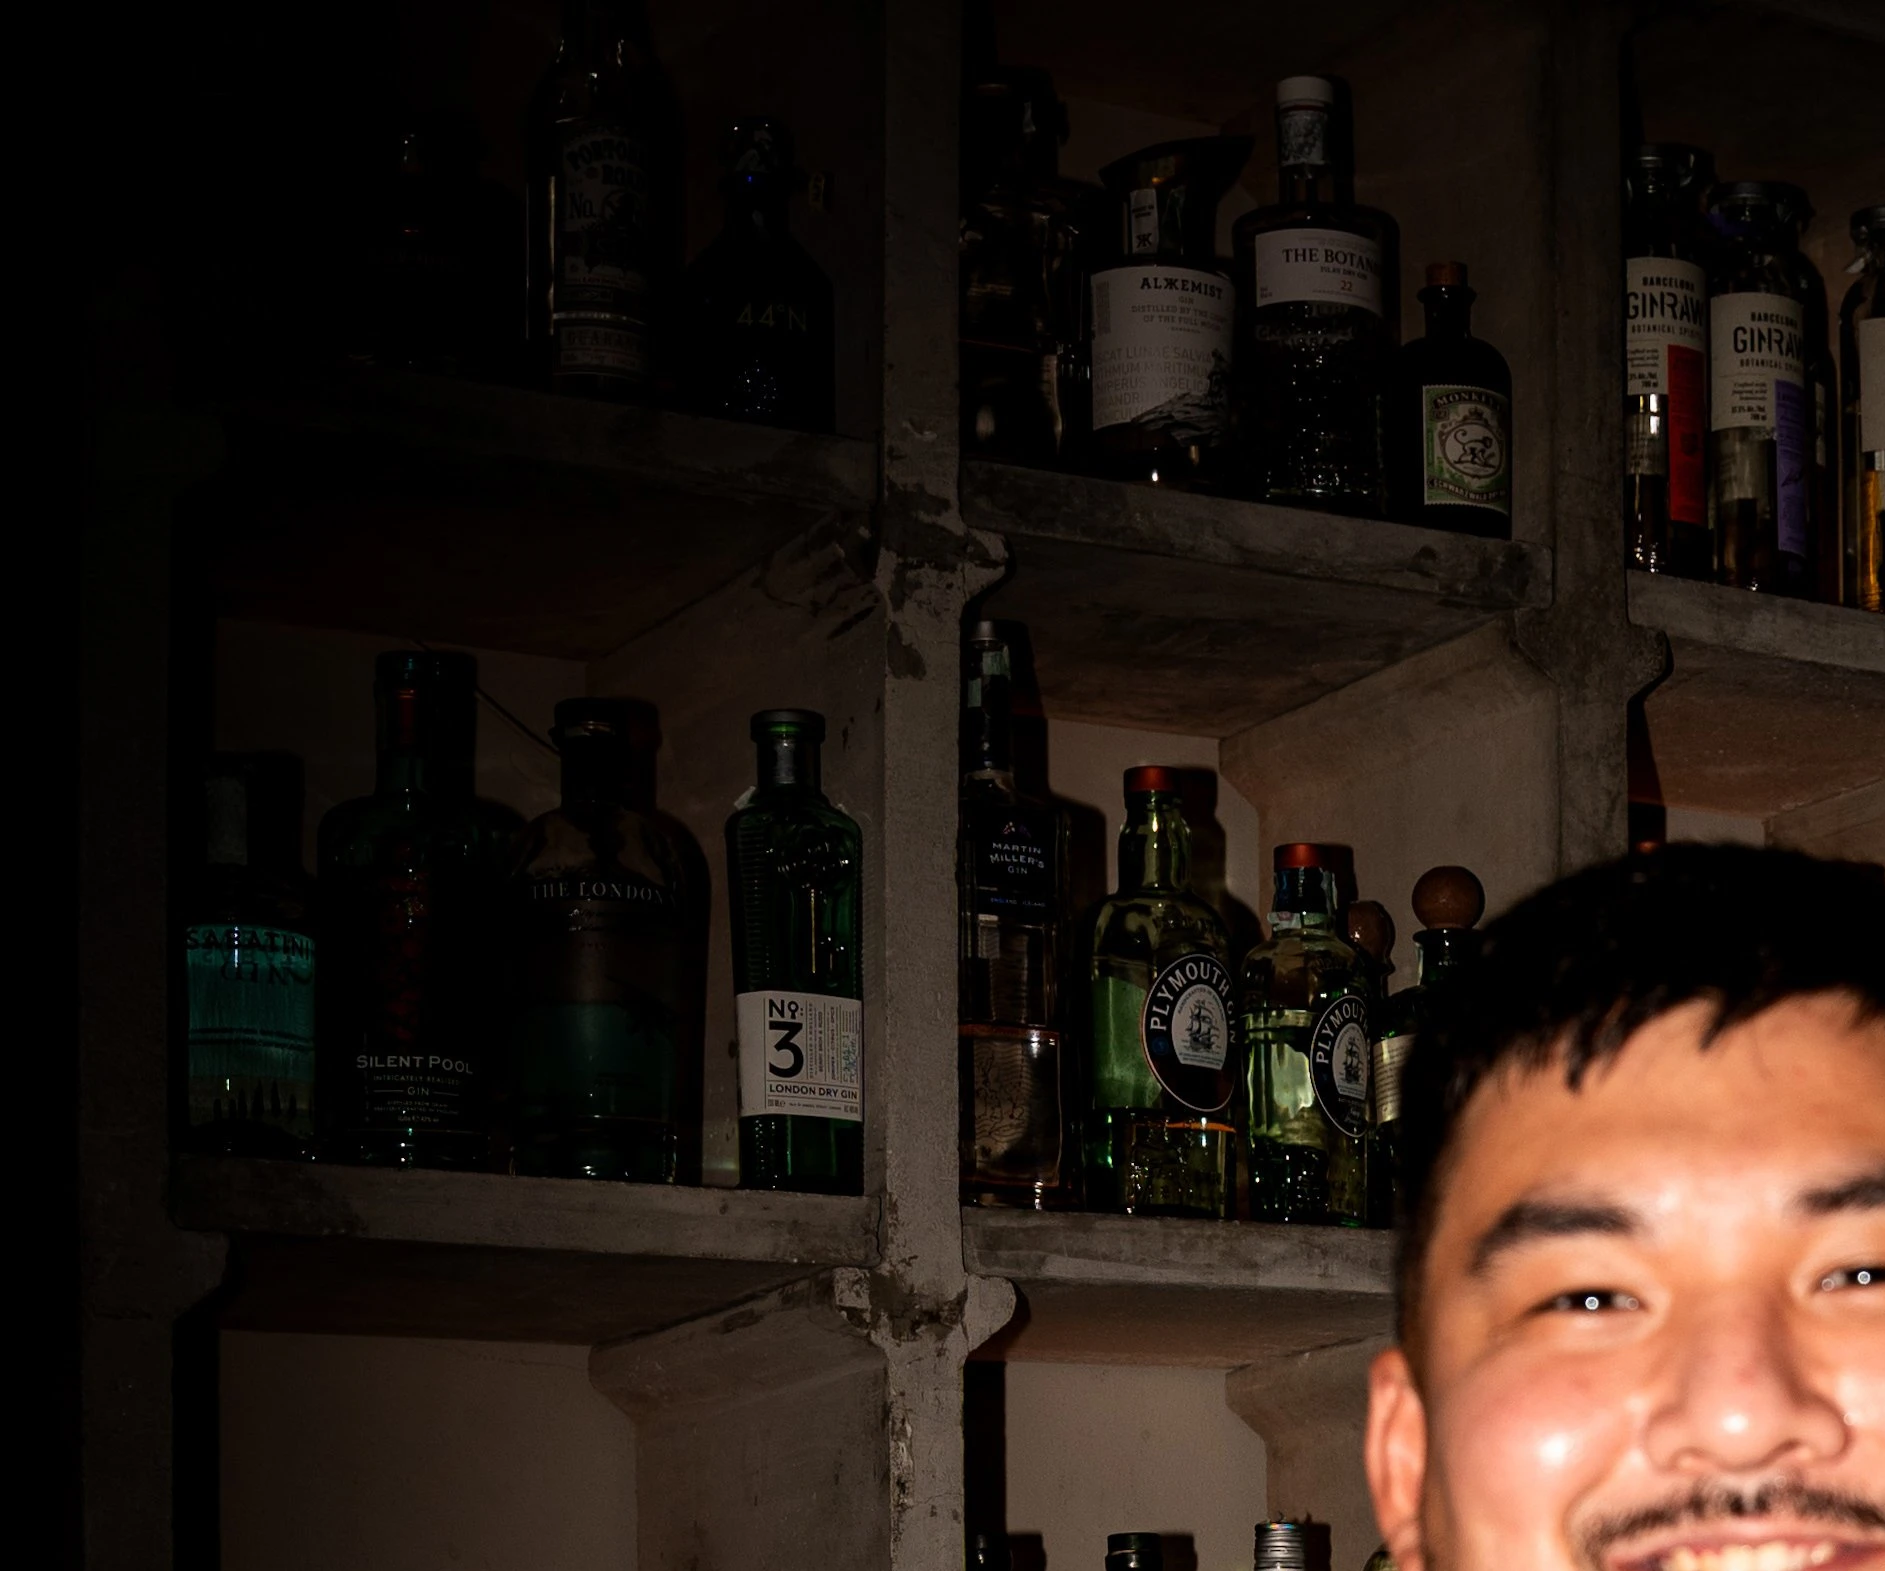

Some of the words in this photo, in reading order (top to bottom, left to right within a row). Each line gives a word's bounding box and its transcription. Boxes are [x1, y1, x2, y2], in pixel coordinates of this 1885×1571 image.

[1282, 248, 1320, 263] THE
[992, 842, 1042, 854] MARTIN
[989, 852, 1045, 869] MILLER'S
[1007, 865, 1028, 875] GIN
[1150, 961, 1228, 1032] PLYMOUTH
[769, 1020, 804, 1078] 3
[356, 1055, 425, 1069] SILENT
[428, 1055, 474, 1075] POOL
[407, 1085, 430, 1096] GIN
[769, 1083, 816, 1096] LONDON
[818, 1085, 839, 1098] DRY
[840, 1089, 858, 1100] GIN
